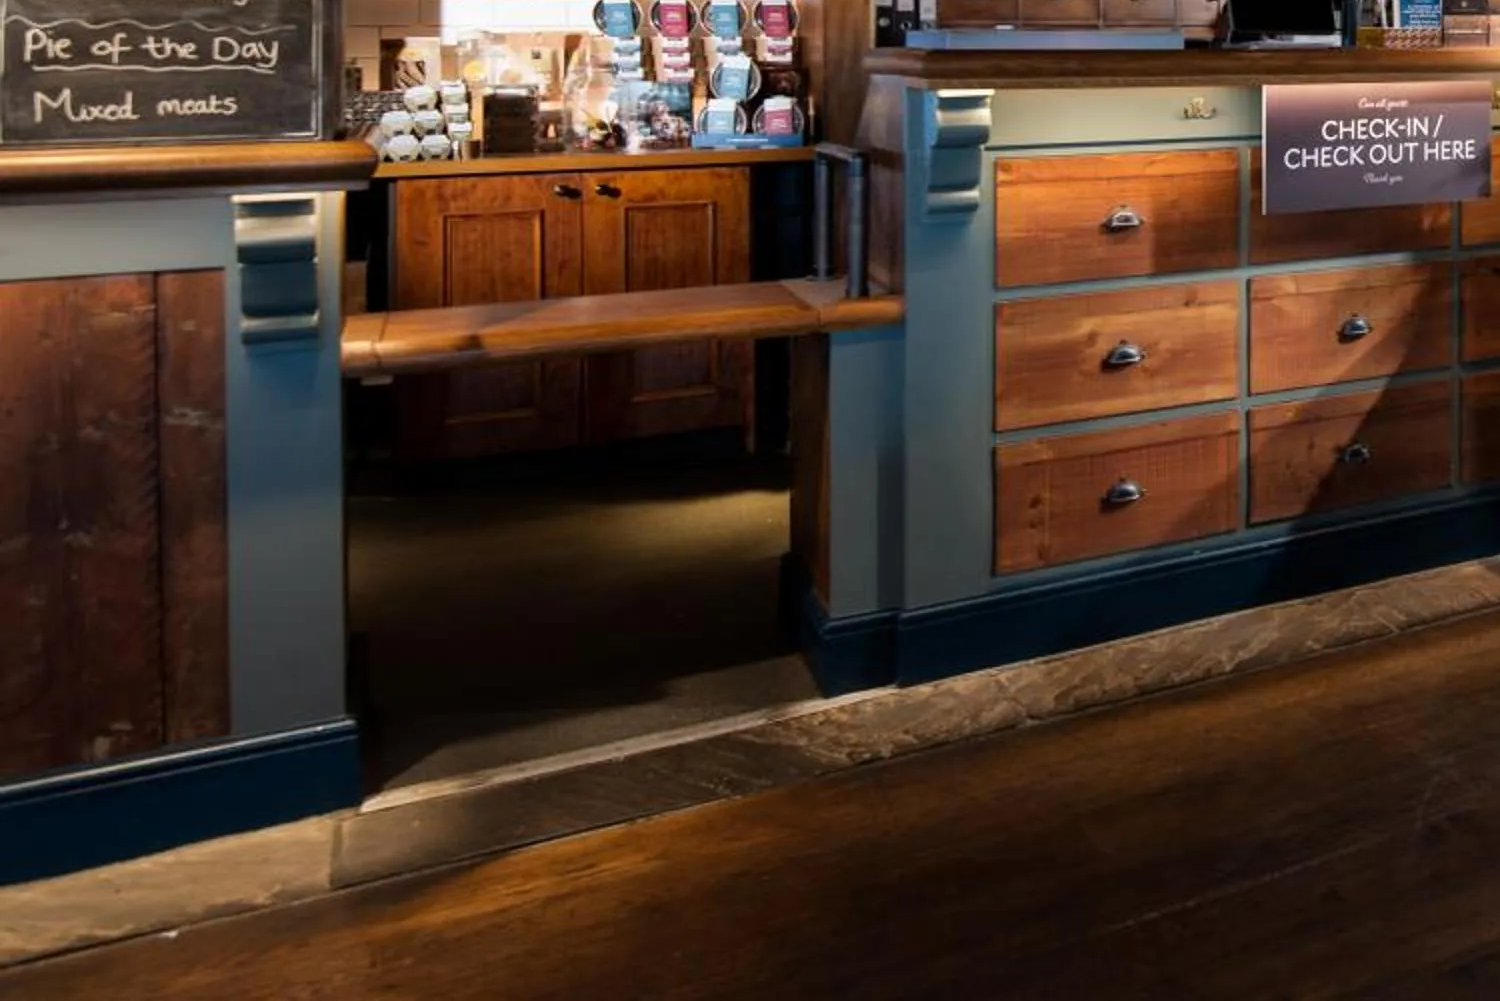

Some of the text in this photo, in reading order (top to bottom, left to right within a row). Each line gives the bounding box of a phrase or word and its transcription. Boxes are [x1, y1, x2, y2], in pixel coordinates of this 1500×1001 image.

[23, 28, 279, 68] Pie of the Day
[33, 87, 238, 123] Mixed meats
[1283, 139, 1476, 170] CHECK OUT HERE
